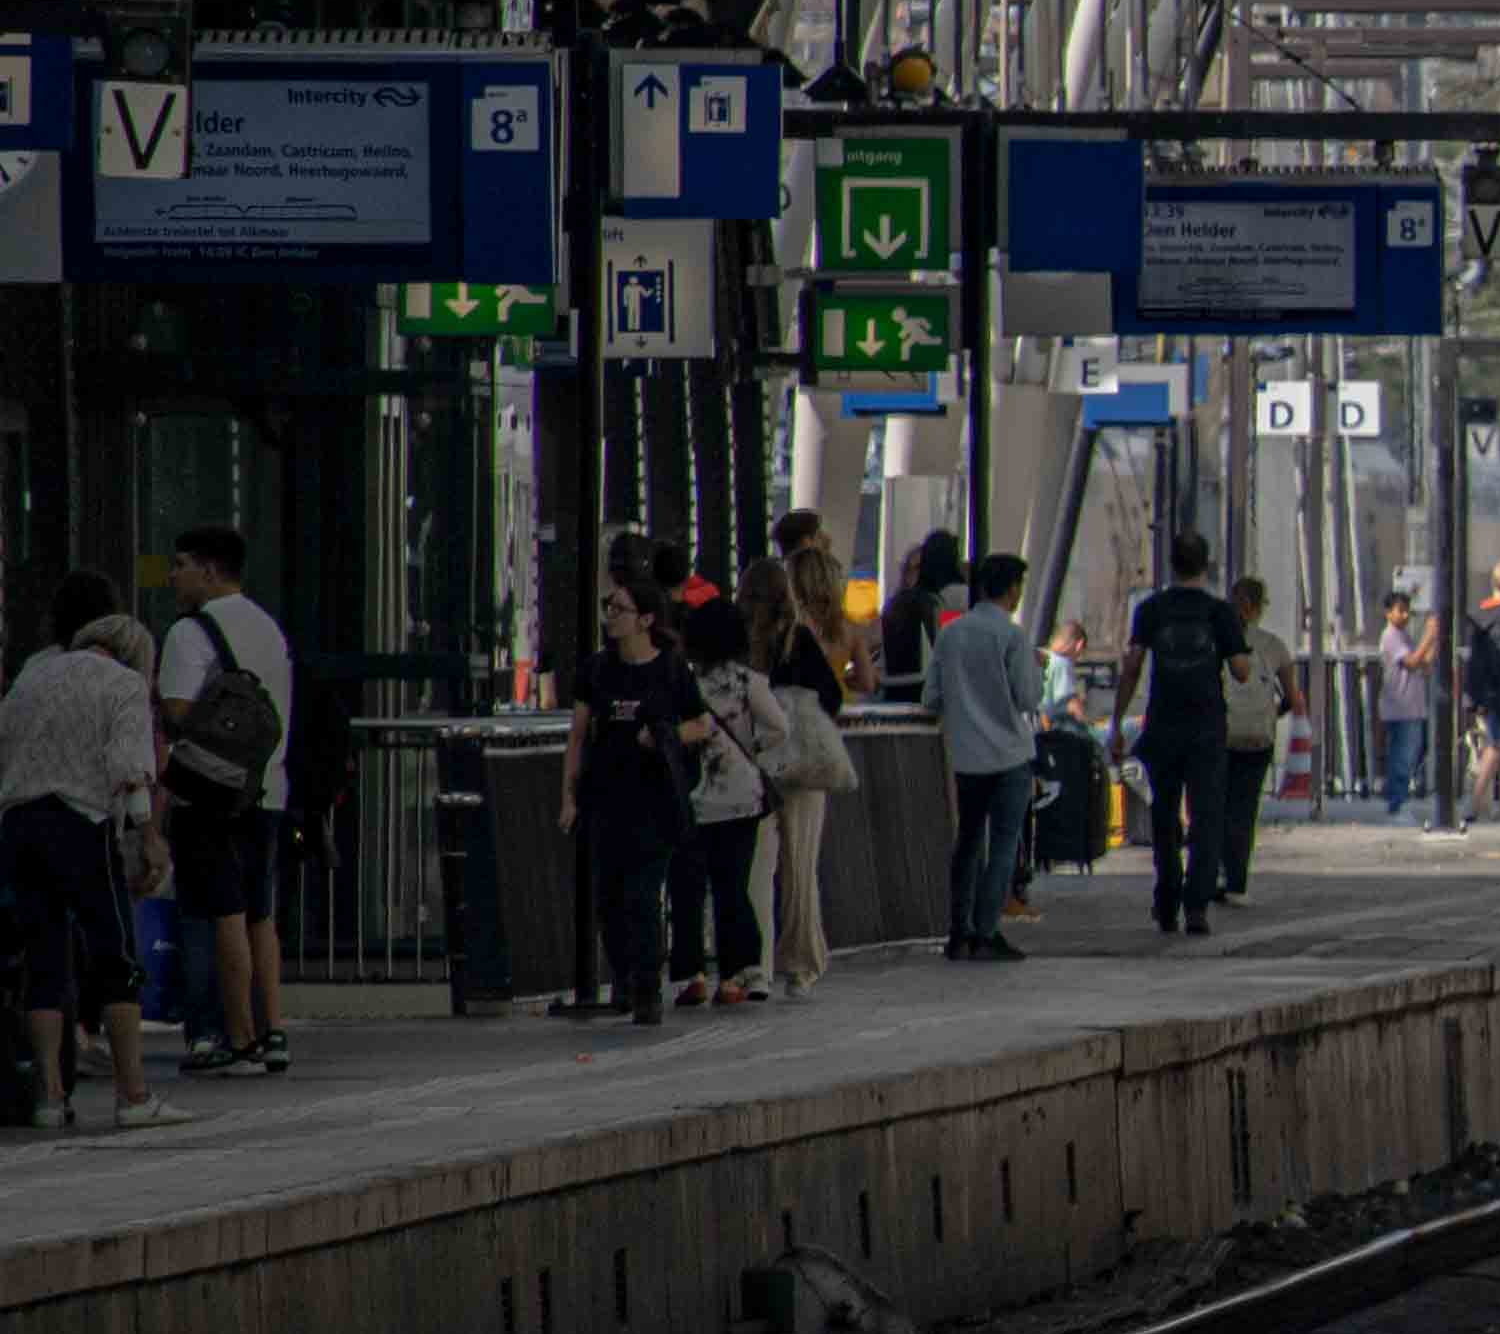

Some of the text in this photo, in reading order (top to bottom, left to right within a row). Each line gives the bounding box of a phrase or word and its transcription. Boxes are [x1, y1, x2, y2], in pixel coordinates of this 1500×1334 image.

[287, 87, 368, 107] Intercity
[112, 89, 178, 170] V
[196, 111, 246, 134] lder
[1082, 357, 1099, 387] E
[1270, 401, 1295, 428] D
[1340, 402, 1365, 428] D
[1472, 431, 1495, 456] V
